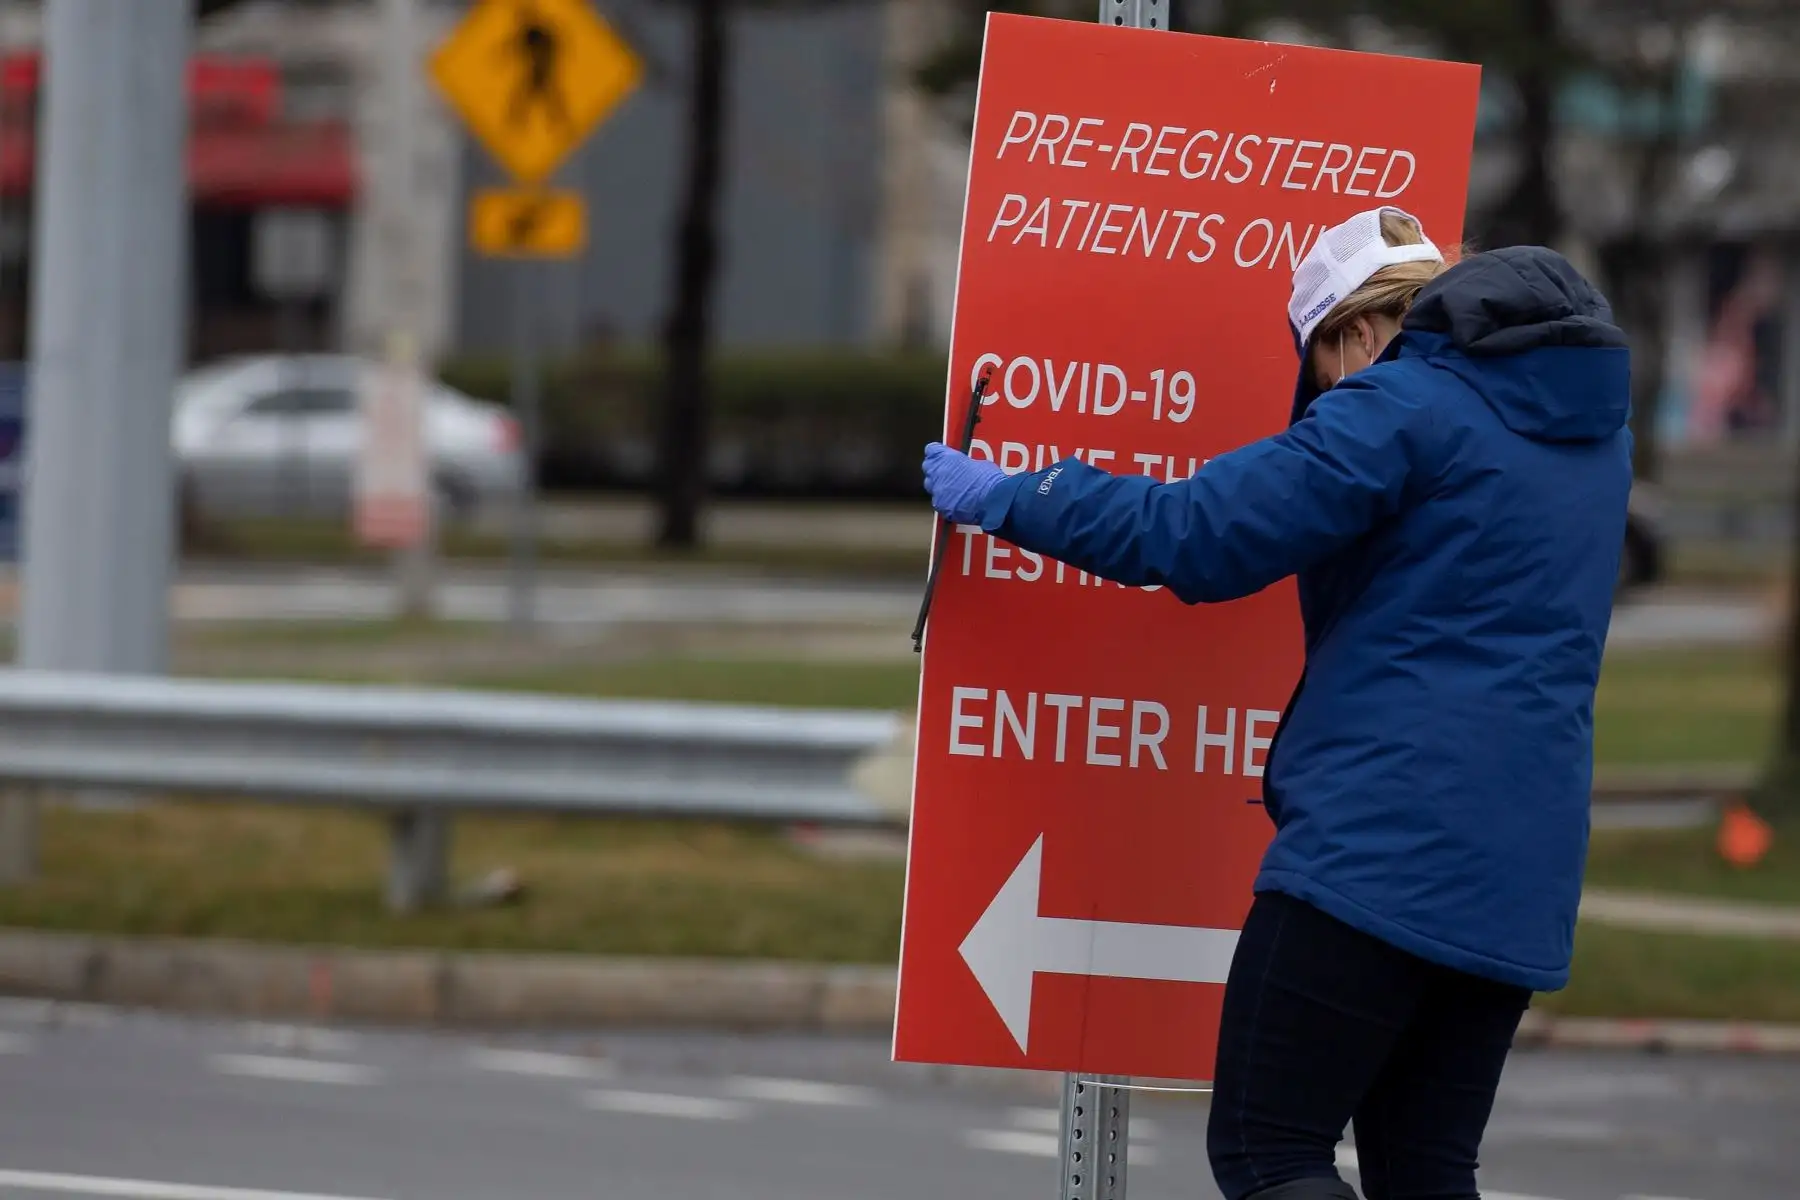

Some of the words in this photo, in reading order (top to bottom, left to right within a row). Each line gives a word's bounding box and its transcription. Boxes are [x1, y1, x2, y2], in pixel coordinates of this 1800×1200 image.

[996, 110, 1416, 199] PRE-REGISTERED
[987, 193, 1225, 264] PATIENTS
[1234, 218, 1327, 271] ON
[1298, 292, 1337, 328] LACROSSE
[970, 352, 1196, 423] COVID-19
[1133, 452, 1211, 485] TH
[948, 686, 1171, 770] ENTER
[1194, 705, 1281, 778] HE
